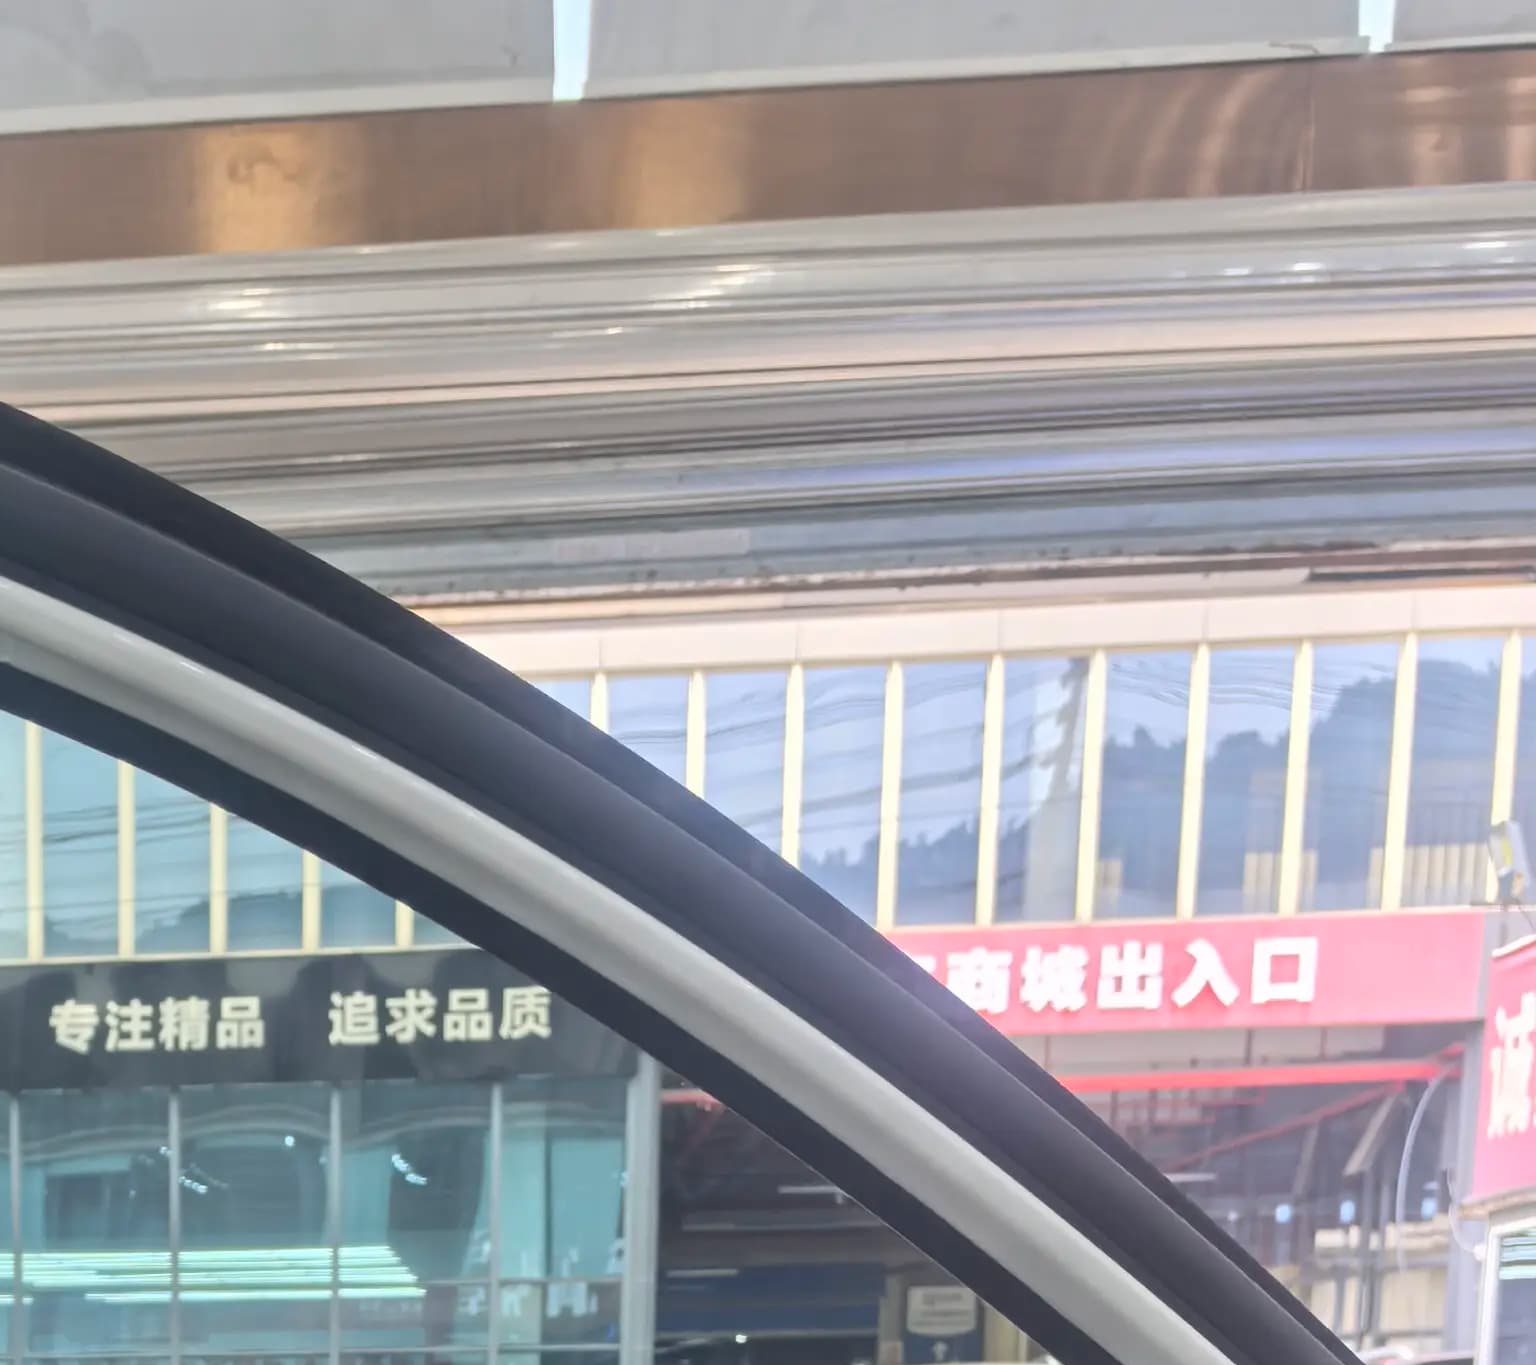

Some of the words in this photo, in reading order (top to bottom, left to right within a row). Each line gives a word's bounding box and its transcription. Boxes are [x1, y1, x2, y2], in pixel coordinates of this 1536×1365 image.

[909, 936, 1319, 1015] 商城出入口
[49, 996, 265, 1053] 专注精品
[328, 985, 552, 1045] 追求品质
